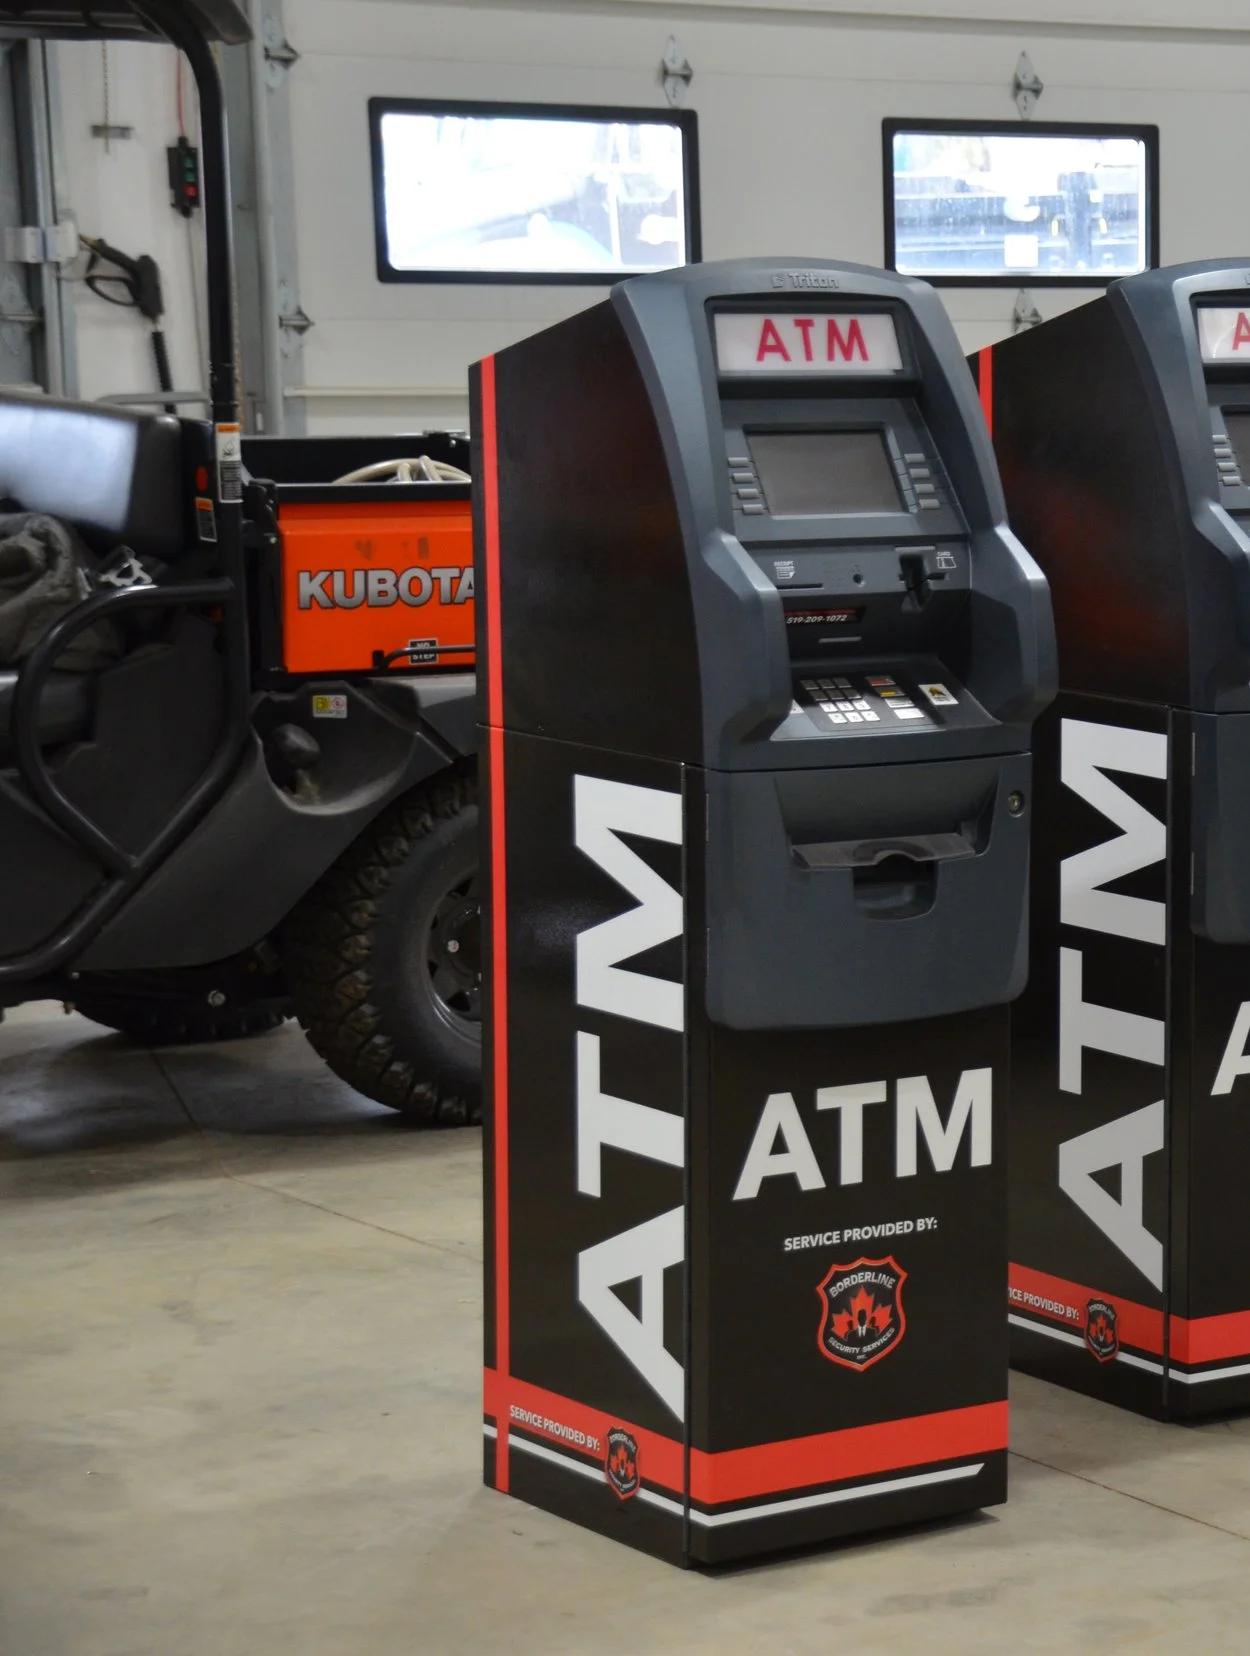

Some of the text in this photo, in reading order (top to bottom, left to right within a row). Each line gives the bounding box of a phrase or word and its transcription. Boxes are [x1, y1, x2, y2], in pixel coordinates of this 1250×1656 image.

[791, 272, 840, 289] Triton
[756, 318, 869, 362] ATM
[298, 566, 475, 610] KUBOTA
[1058, 717, 1168, 1293] ATM
[574, 773, 685, 1424] ATM
[732, 1066, 993, 1201] ATM
[783, 1216, 939, 1251] SERVICE PROVIDED BY:
[828, 1271, 897, 1298] BORDERLINE
[1023, 1292, 1065, 1316] PROVIDED
[1066, 1307, 1080, 1321] BY:
[828, 1327, 896, 1354] SECURITY SERVICES
[509, 1404, 601, 1452] SERVICE PROVIDED BY:
